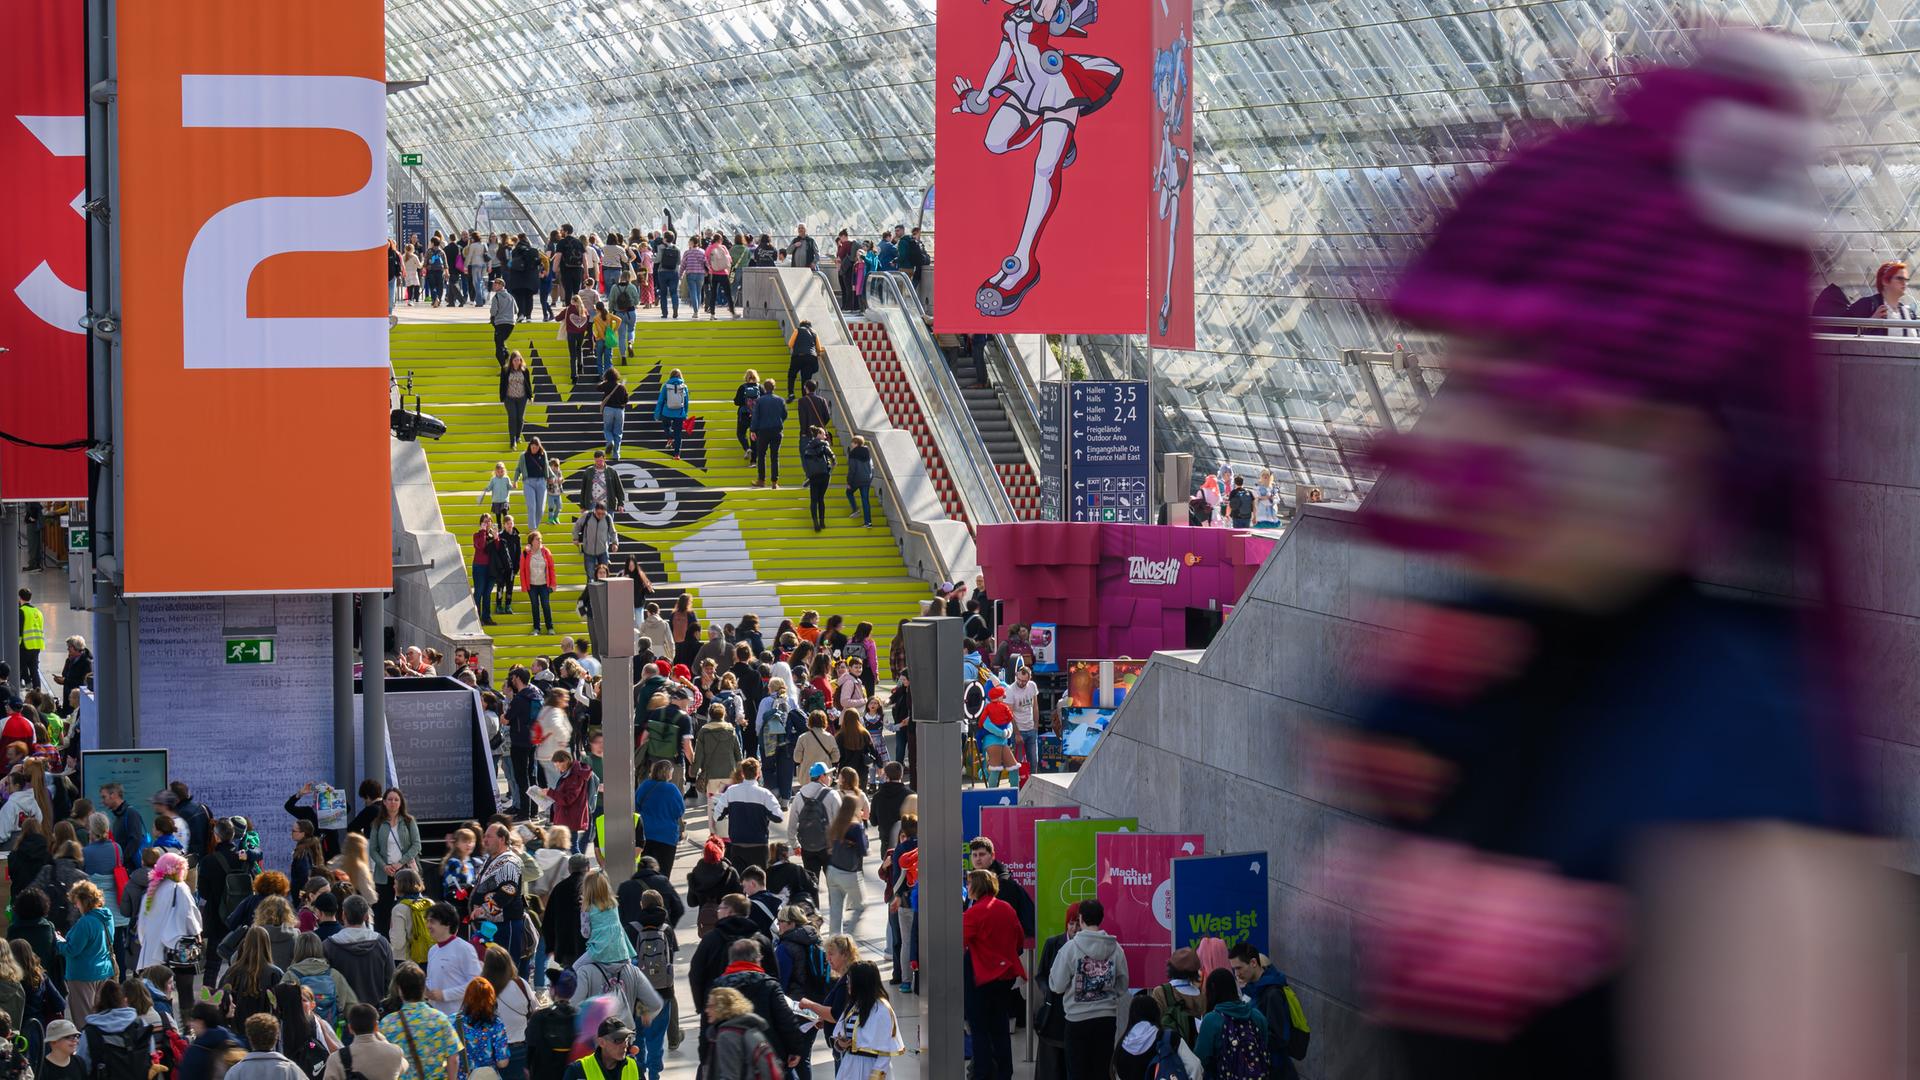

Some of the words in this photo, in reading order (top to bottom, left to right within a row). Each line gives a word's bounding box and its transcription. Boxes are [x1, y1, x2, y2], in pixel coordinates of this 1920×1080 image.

[182, 74, 389, 369] 2
[1113, 386, 1137, 404] 3,5
[1113, 406, 1137, 424] 2,4
[1086, 425, 1121, 434] Freigelände
[1086, 434, 1112, 442] Outdoor
[1086, 445, 1128, 454] Eingangshalle
[1129, 445, 1140, 453] Ost
[1110, 867, 1138, 877] Mach
[1123, 873, 1152, 886] mit!
[1189, 913, 1232, 934] Was
[1235, 910, 1258, 929] ist
